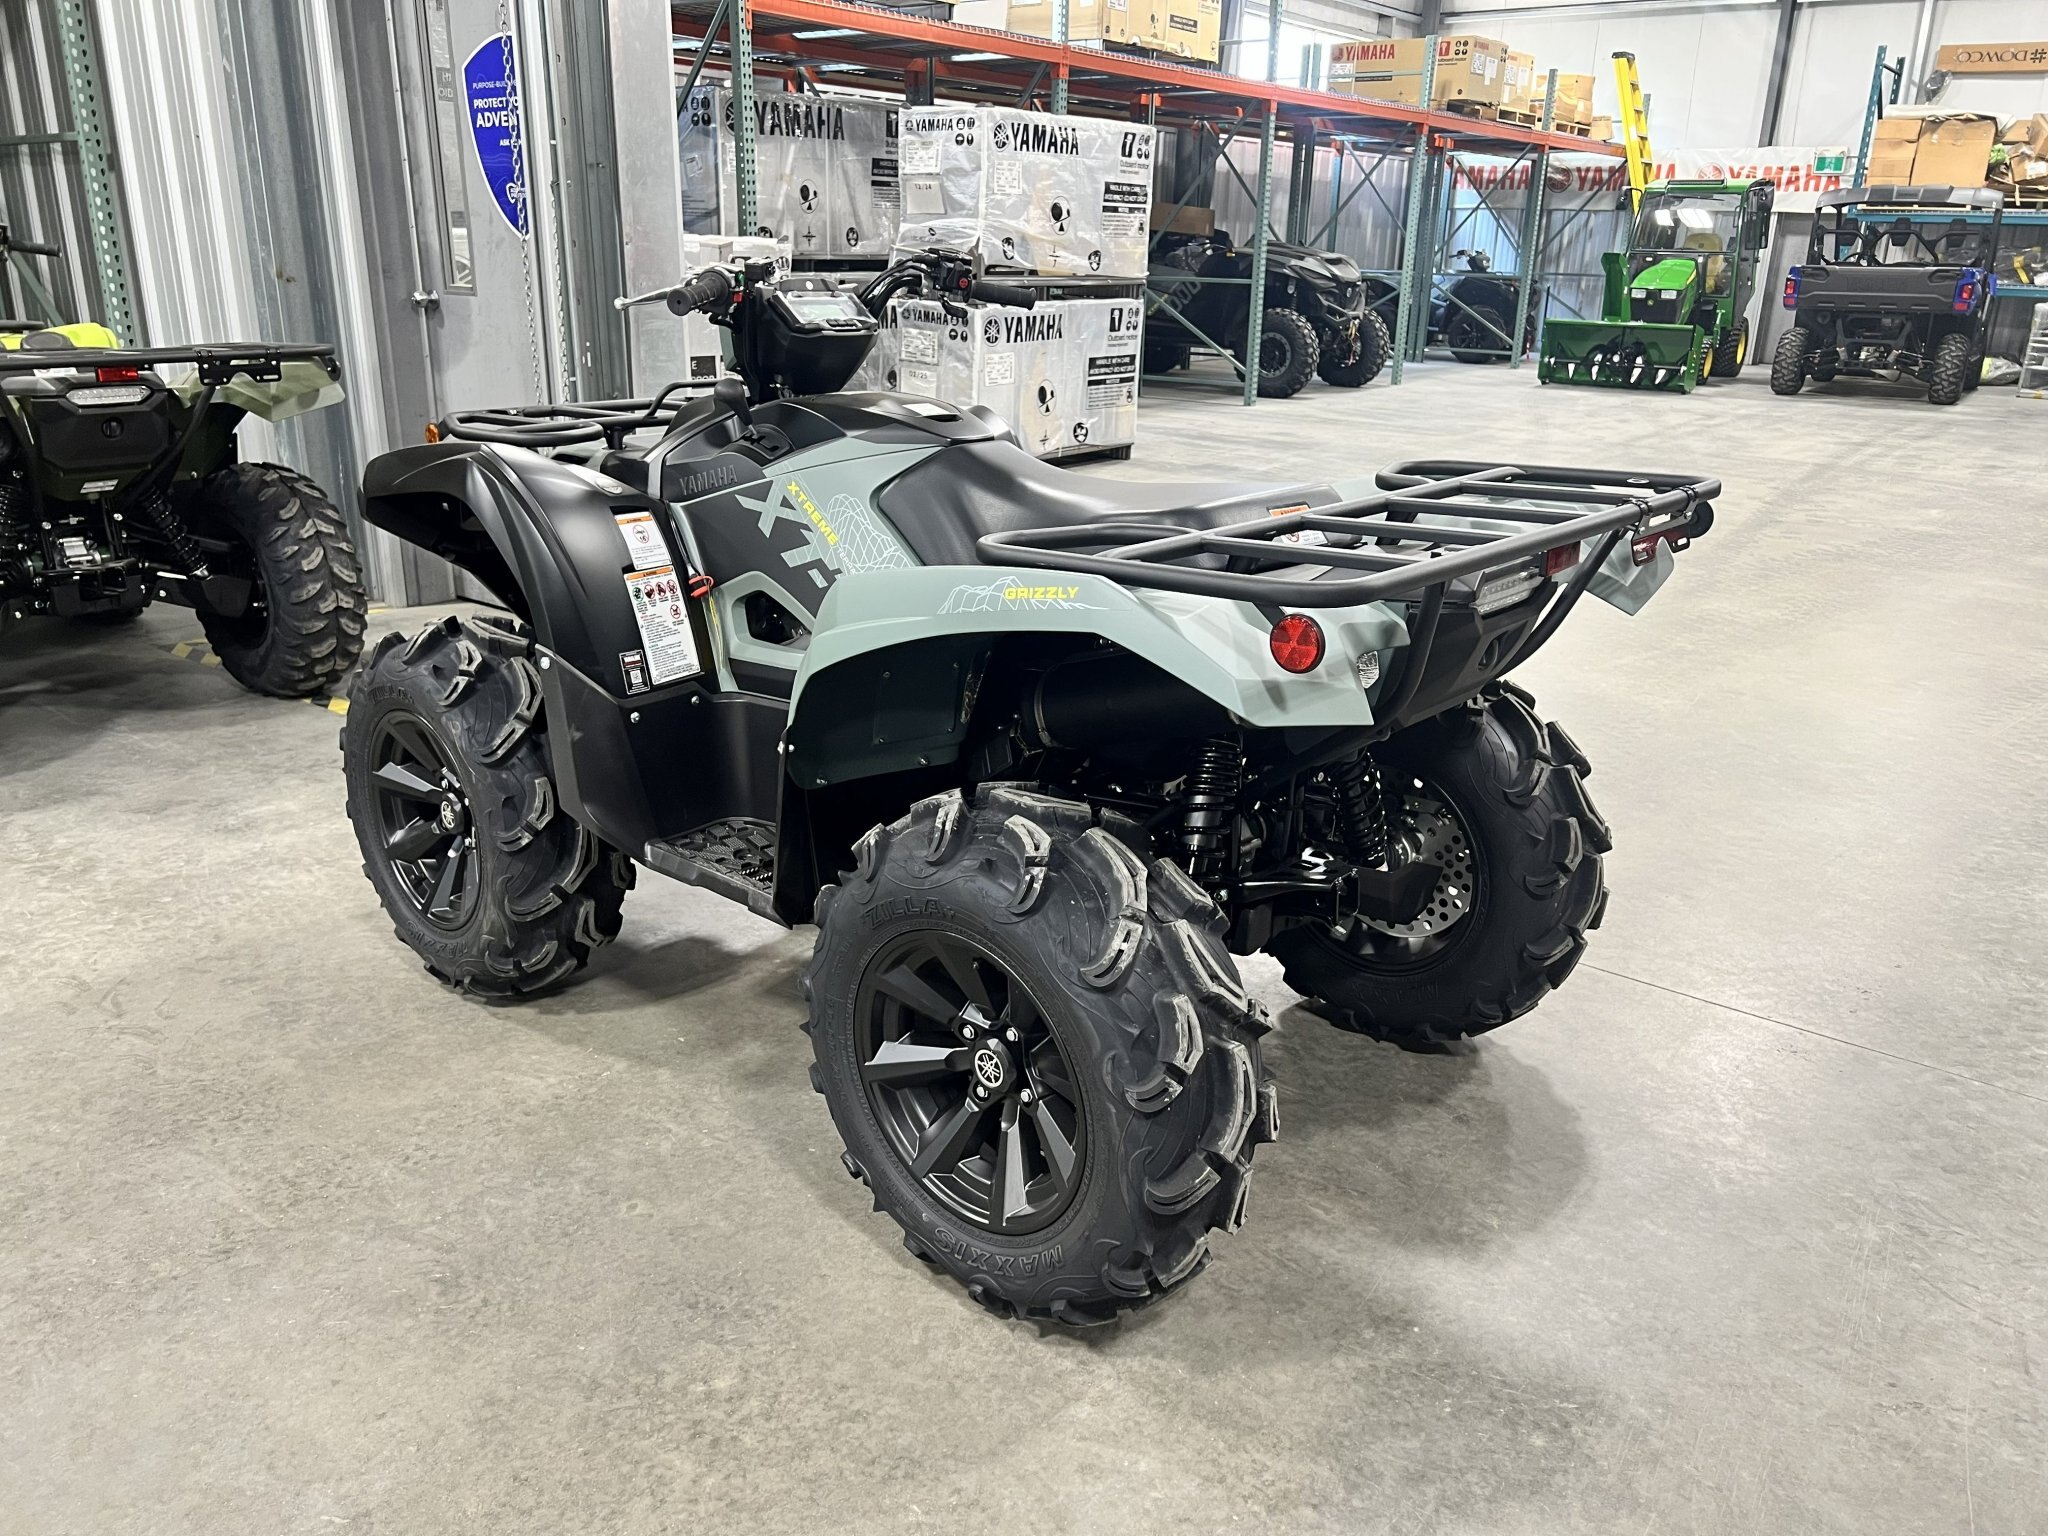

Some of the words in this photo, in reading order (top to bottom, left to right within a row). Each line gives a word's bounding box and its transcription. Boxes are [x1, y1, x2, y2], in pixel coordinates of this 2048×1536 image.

[1345, 43, 1395, 61] YAMAHA
[472, 80, 511, 90] PURPOSE-BUIL
[473, 97, 508, 110] PROTECT
[476, 109, 519, 128] ADVEN
[753, 100, 845, 141] YAMAHA
[915, 118, 954, 132] YAMAHA
[1011, 122, 1079, 155] YAMAHA
[1452, 164, 1529, 190] AMAHA
[912, 308, 949, 326] YAMAHA
[1004, 313, 1063, 344] YAMAHA
[679, 463, 738, 496] YAMAHA
[786, 480, 839, 546] XTREME
[1004, 586, 1080, 600] GRIZZLY
[864, 895, 945, 930] ZILLA
[933, 1226, 1065, 1278] MAXXIS
